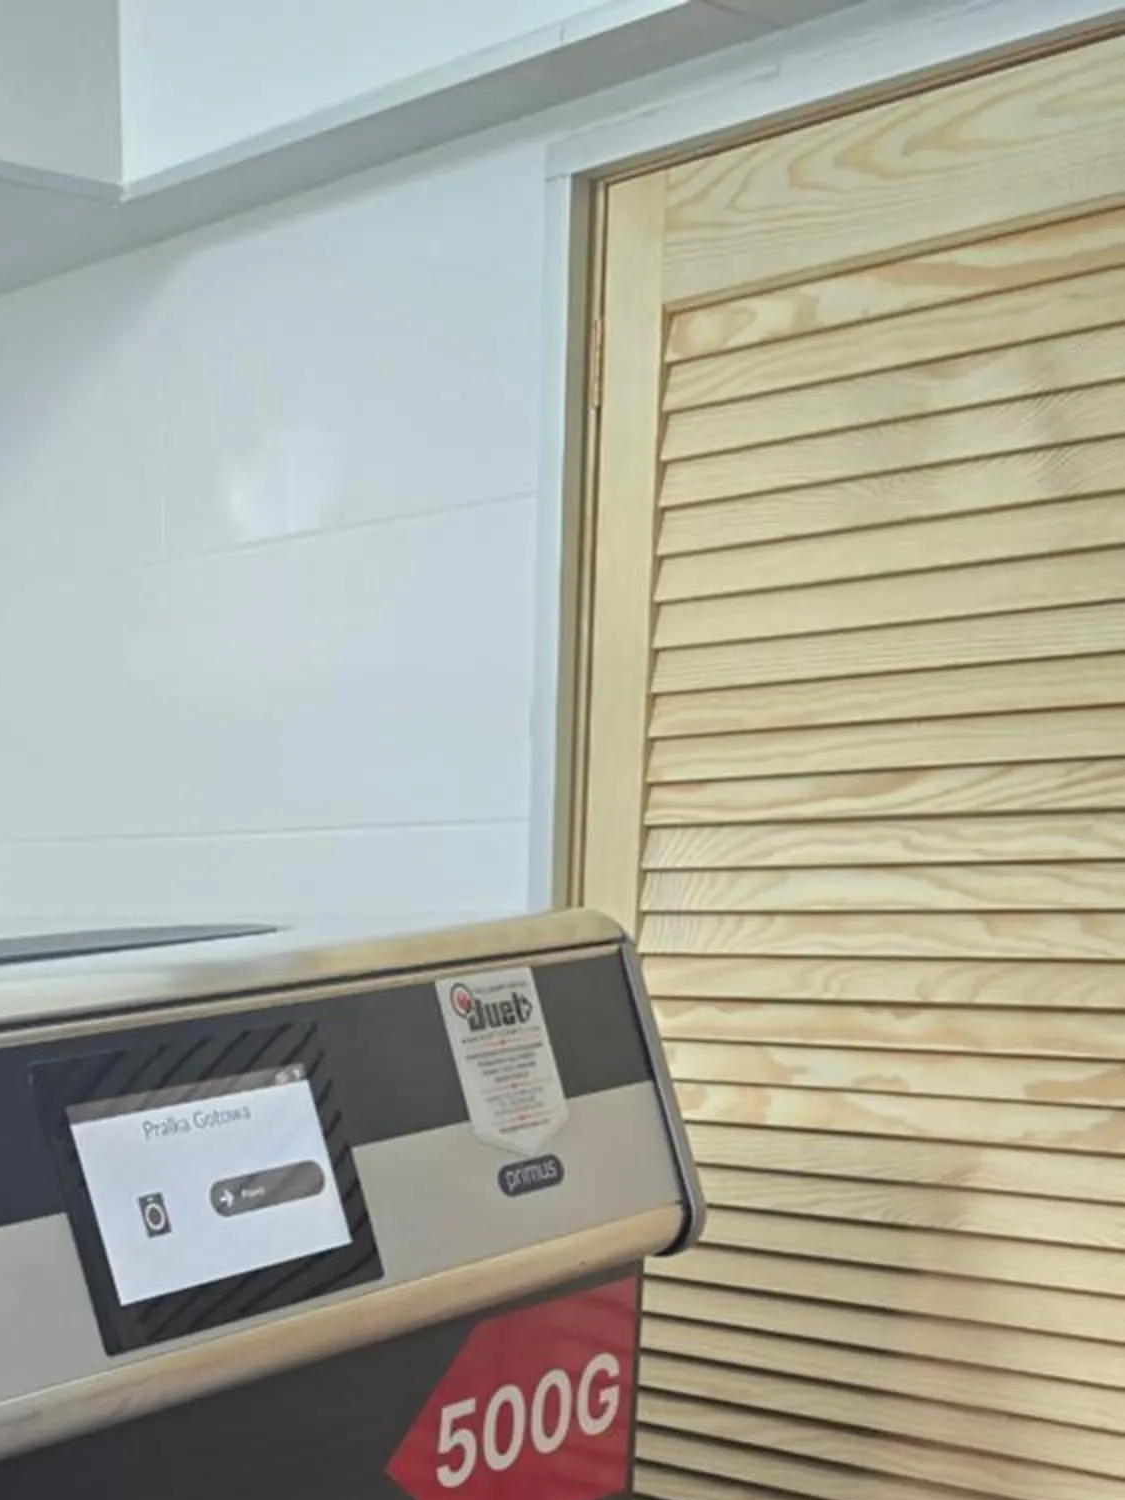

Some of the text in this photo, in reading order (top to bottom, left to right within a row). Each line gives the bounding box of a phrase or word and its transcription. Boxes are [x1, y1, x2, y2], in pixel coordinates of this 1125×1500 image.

[142, 1105, 252, 1141] Pralka Gotowa
[504, 1159, 557, 1193] primus
[435, 1352, 621, 1489] 500G
